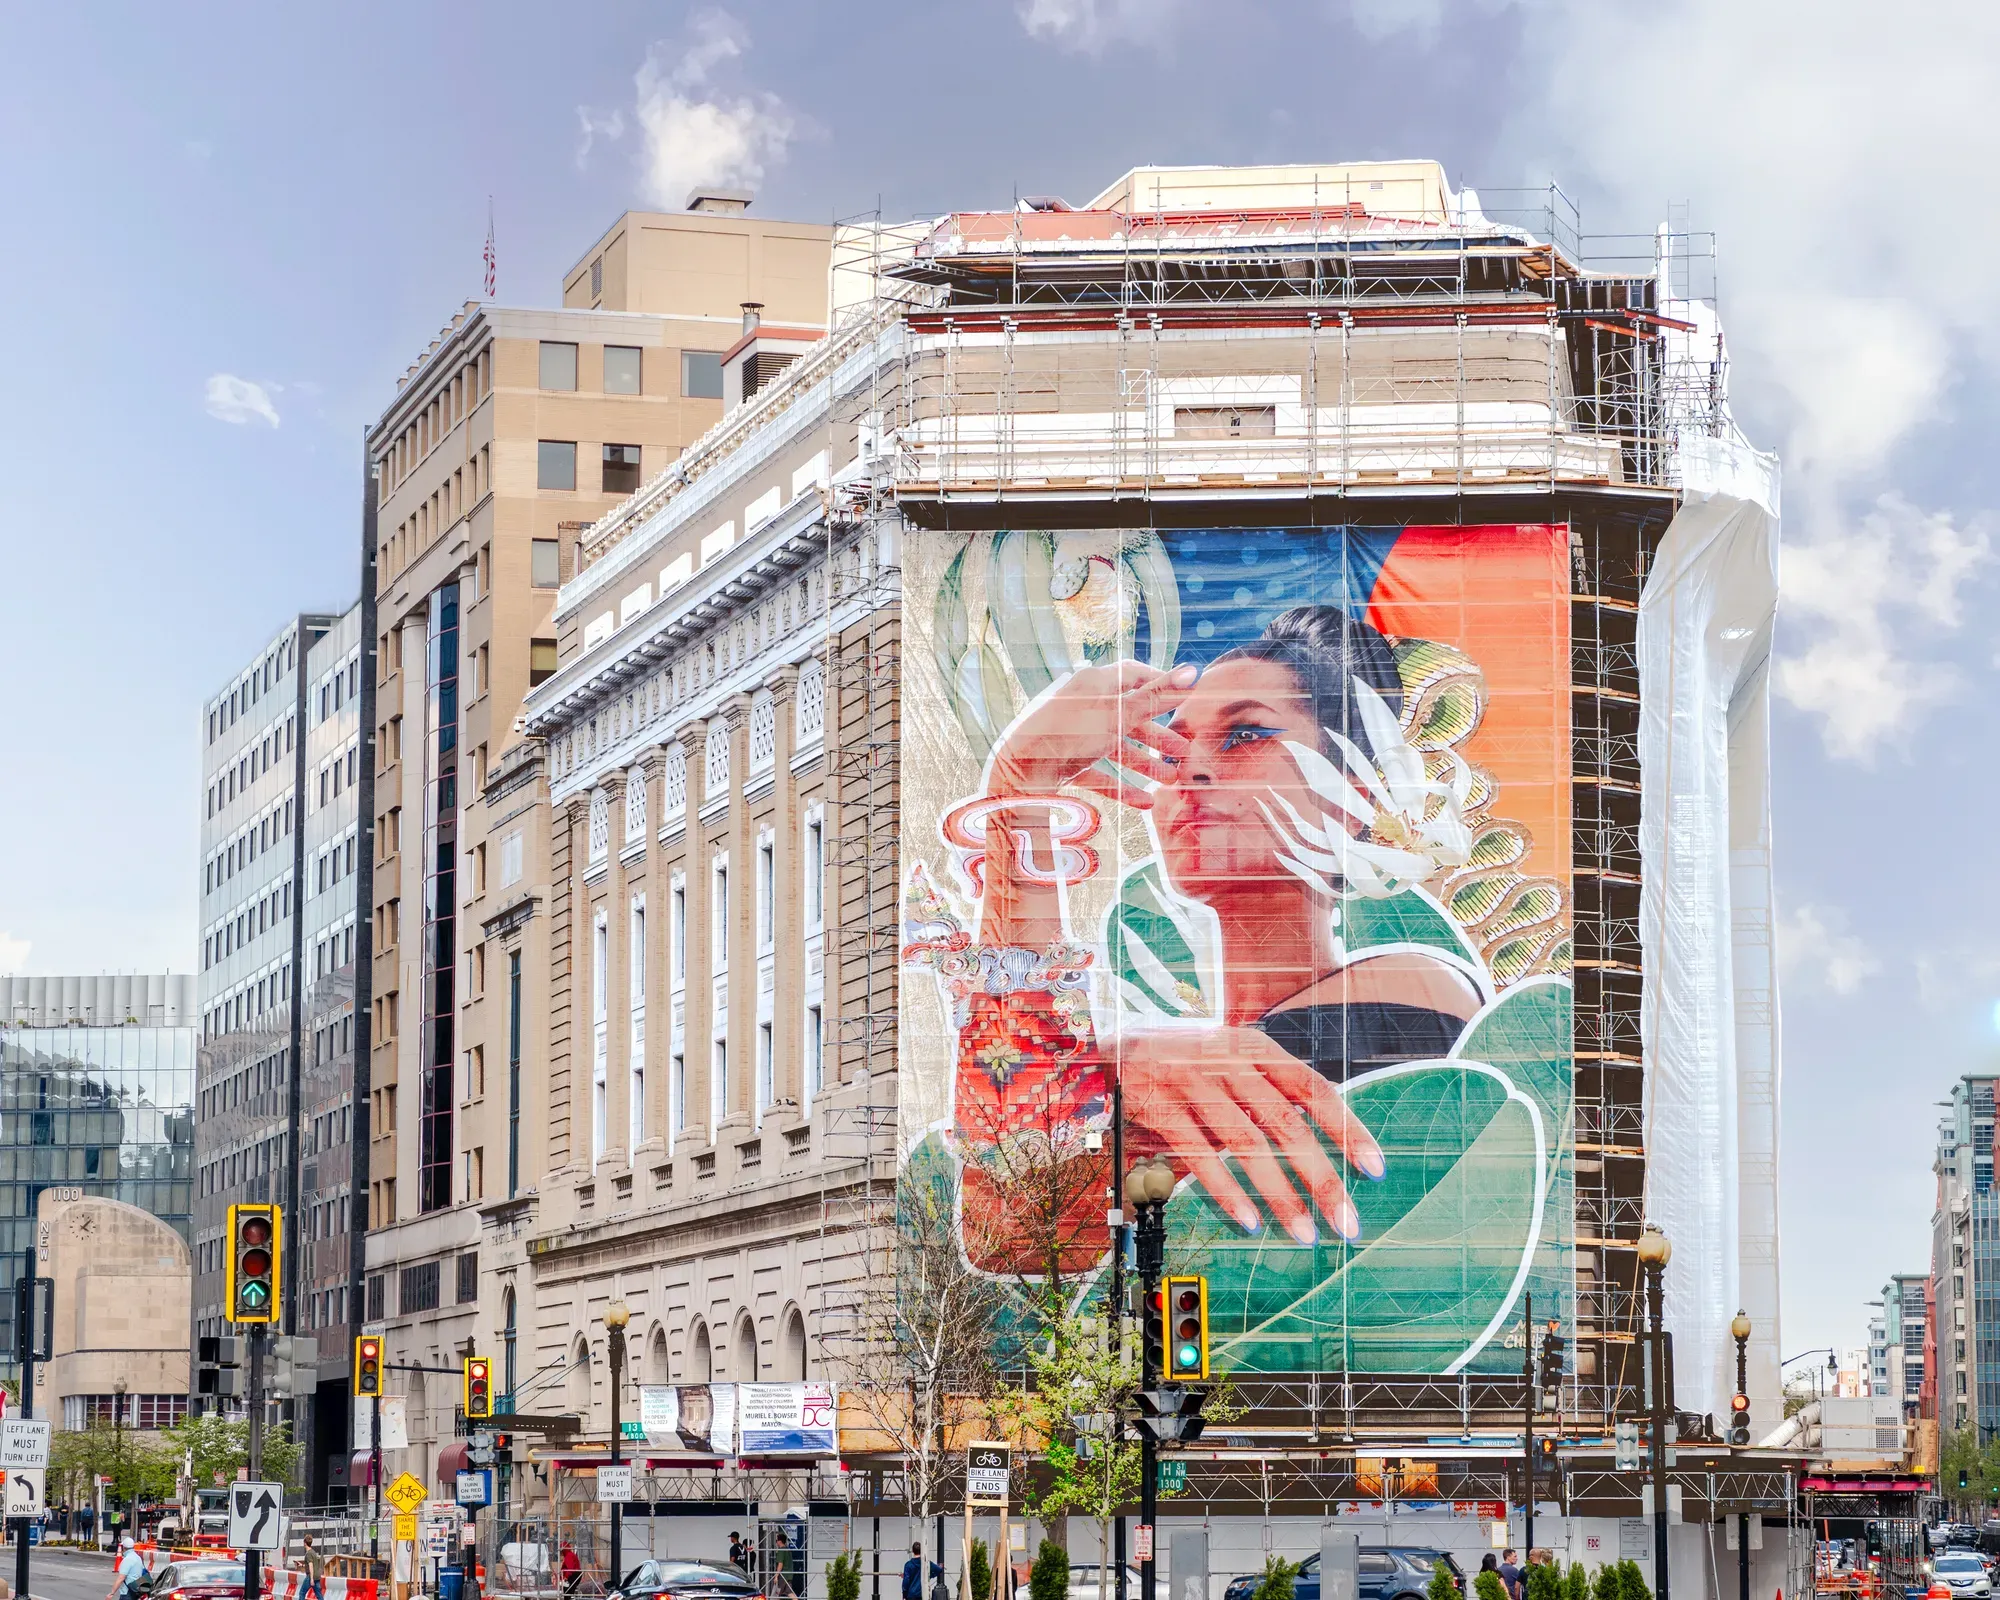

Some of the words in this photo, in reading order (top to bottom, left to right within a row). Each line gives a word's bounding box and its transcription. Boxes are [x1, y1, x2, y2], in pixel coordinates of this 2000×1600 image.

[52, 1188, 79, 1201] 1100
[40, 1221, 49, 1261] NEW
[802, 1407, 830, 1427] DC
[6, 1425, 24, 1433] LEFT
[27, 1426, 45, 1435] LANE
[13, 1439, 37, 1449] MUST
[4, 1453, 23, 1461] TURN
[26, 1454, 44, 1462] LEFT
[1163, 1463, 1171, 1476] H
[1175, 1469, 1186, 1477] NW
[606, 1480, 624, 1488] MUST
[976, 1482, 1000, 1491] ENDS
[1160, 1479, 1181, 1489] 1300
[12, 1504, 37, 1512] ONLY
